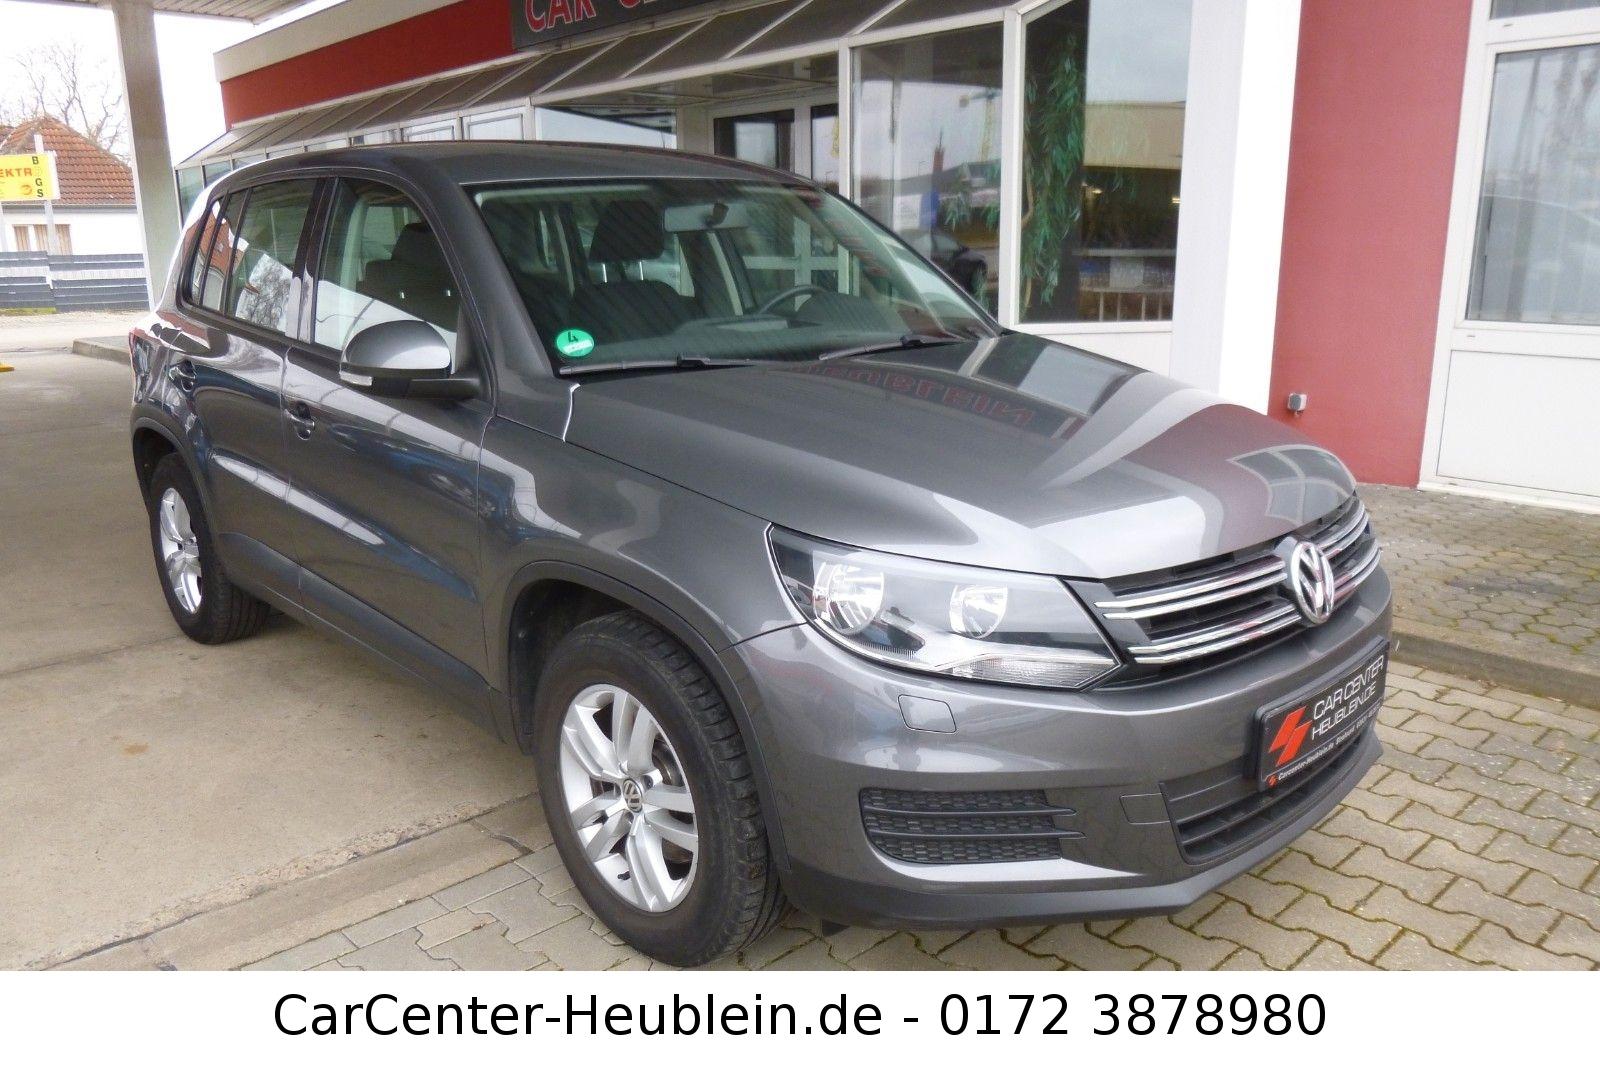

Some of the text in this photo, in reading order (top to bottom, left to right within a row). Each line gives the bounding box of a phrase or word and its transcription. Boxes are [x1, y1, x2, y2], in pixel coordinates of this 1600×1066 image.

[567, 331, 579, 343] 4
[1314, 688, 1343, 720] CAR
[1345, 655, 1384, 700] CENTER
